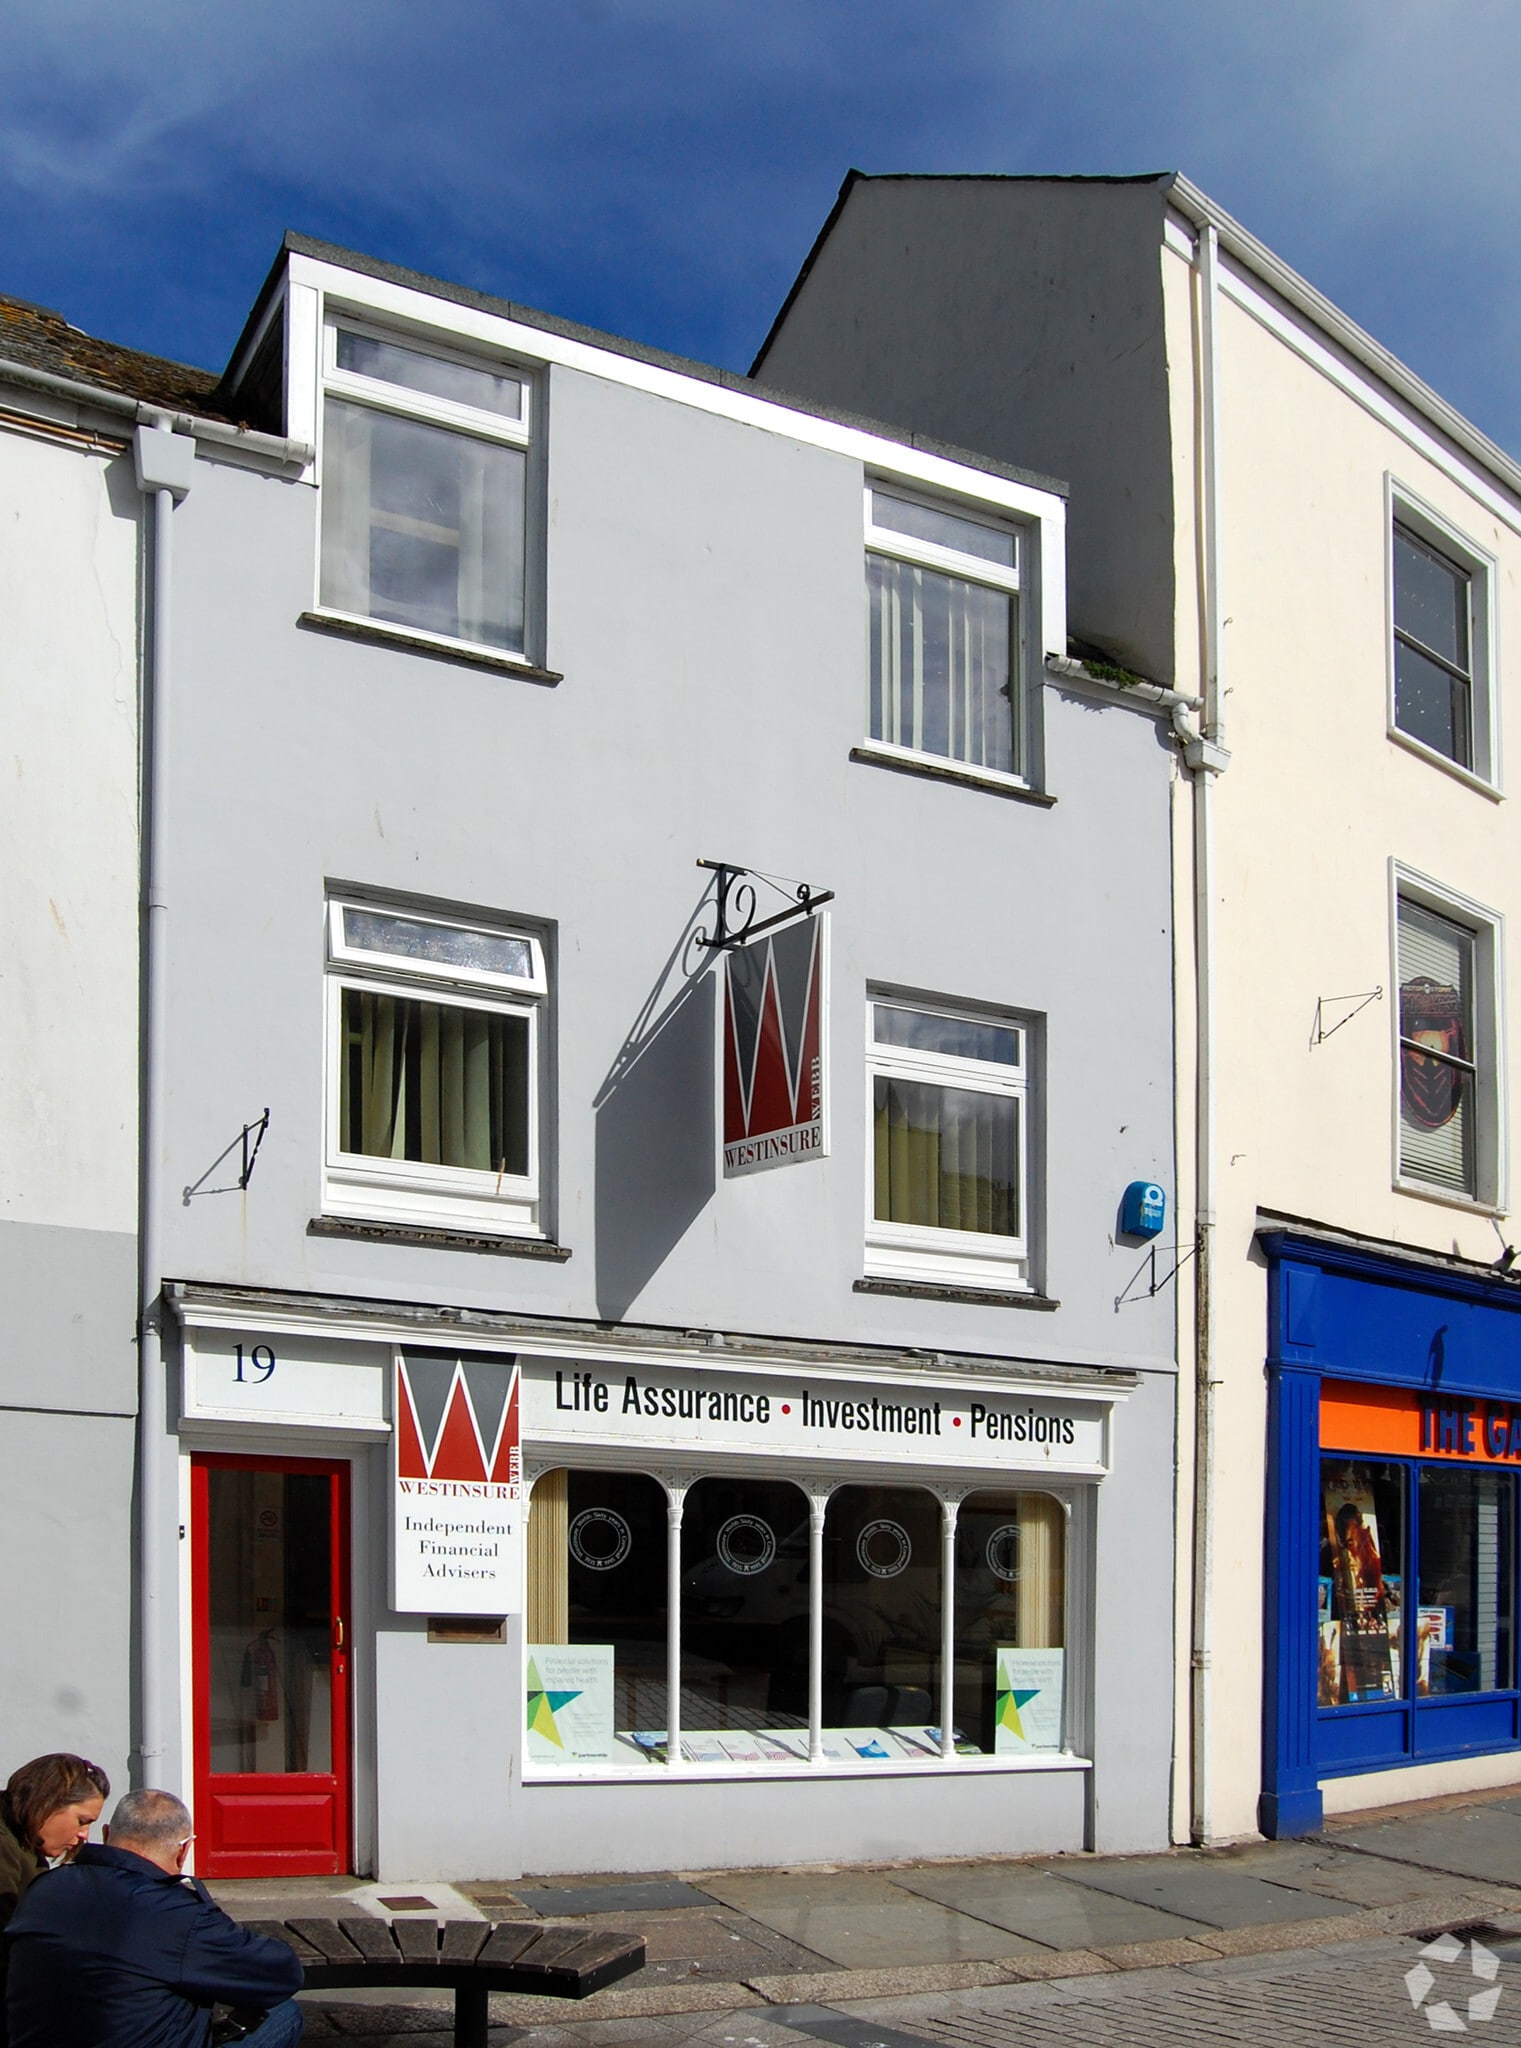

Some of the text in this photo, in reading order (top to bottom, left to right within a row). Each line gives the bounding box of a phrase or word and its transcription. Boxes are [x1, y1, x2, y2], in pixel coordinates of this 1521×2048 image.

[811, 1055, 821, 1121] WEBB
[724, 1126, 821, 1169] WESTINSURE
[232, 1343, 275, 1383] 19
[556, 1371, 1074, 1444] Life Assurance Investment Pensions
[1420, 1396, 1475, 1453] THE
[509, 1446, 520, 1484] WEBB
[400, 1481, 520, 1500] WESTINSURE
[405, 1516, 512, 1536] Independent
[420, 1540, 499, 1557] Financial
[423, 1563, 496, 1580] Advisers
